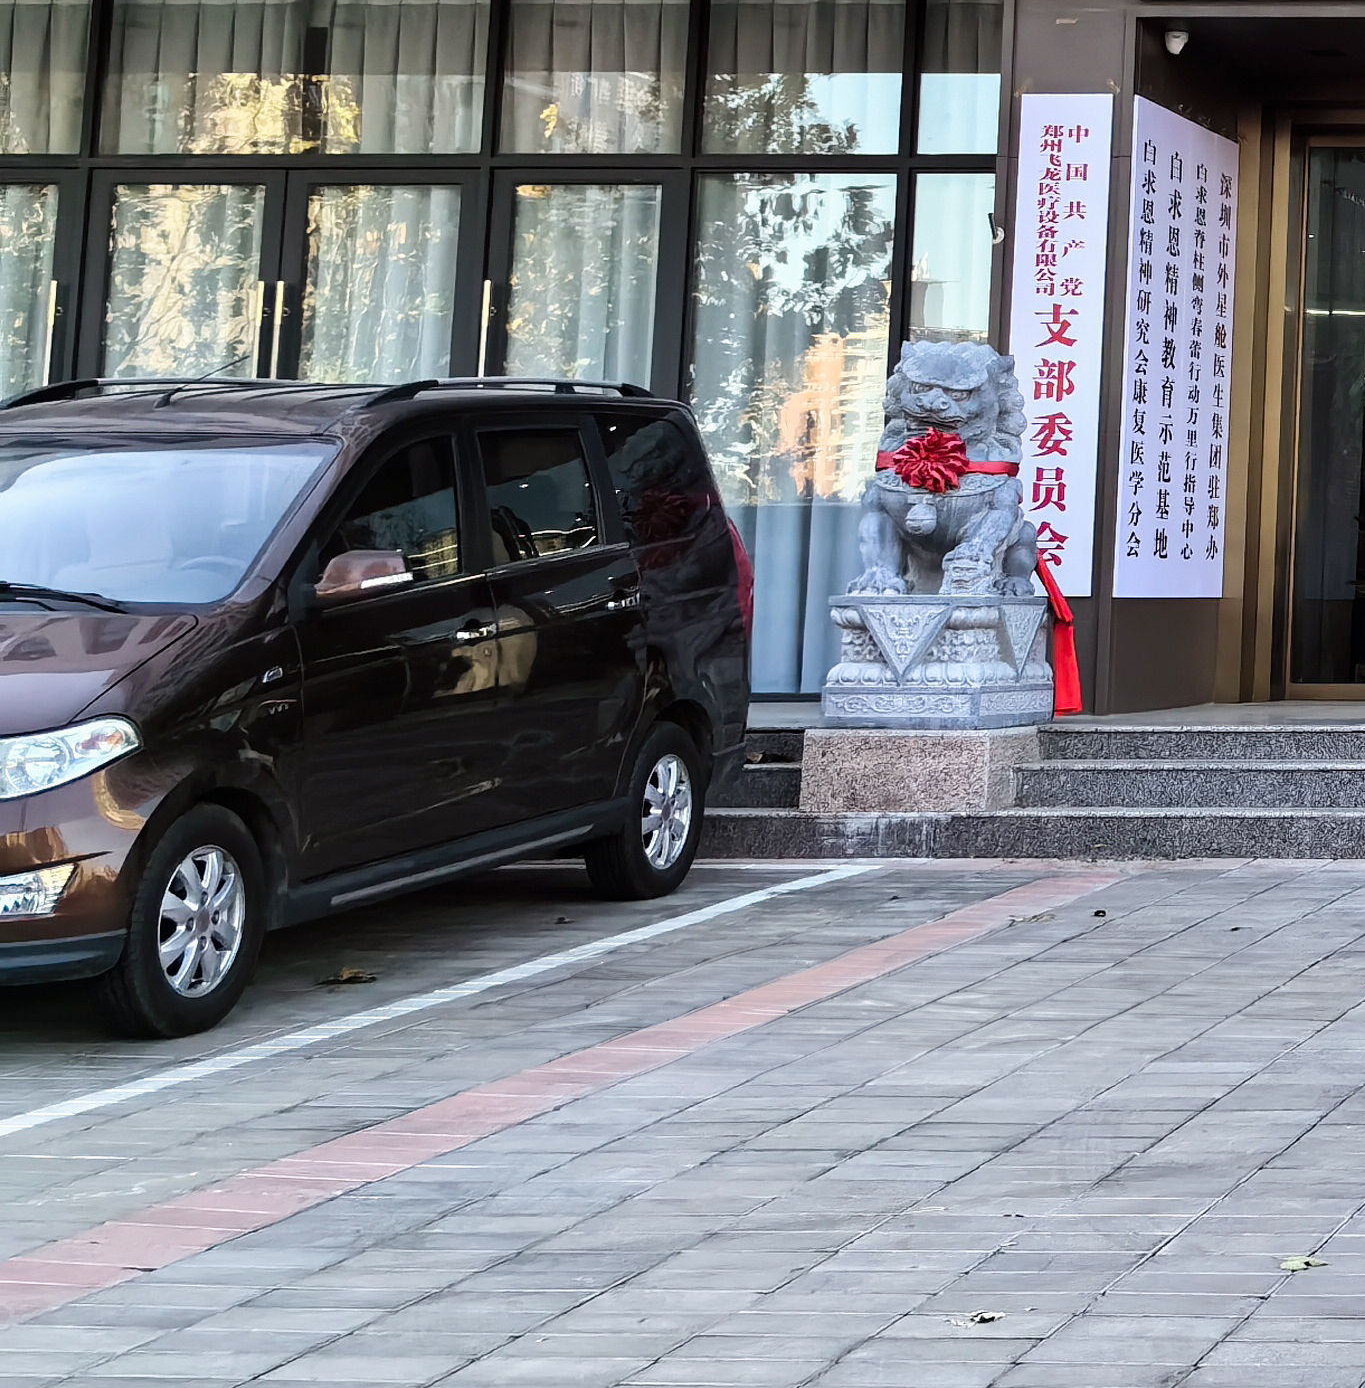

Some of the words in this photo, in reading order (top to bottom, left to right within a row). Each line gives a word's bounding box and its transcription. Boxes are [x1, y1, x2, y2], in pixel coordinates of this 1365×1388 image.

[1034, 124, 1065, 297] 郑州飞龙医疗设备有限公司
[1060, 124, 1090, 297] 中国共产党
[1126, 139, 1158, 558] 白求恩精神研究会康复医学分会
[1153, 151, 1184, 560] 白求恩精神教育示范基地
[1205, 172, 1233, 561] 深圳市外星舱医生集团驻郑办
[1029, 303, 1079, 567] 支部委员会
